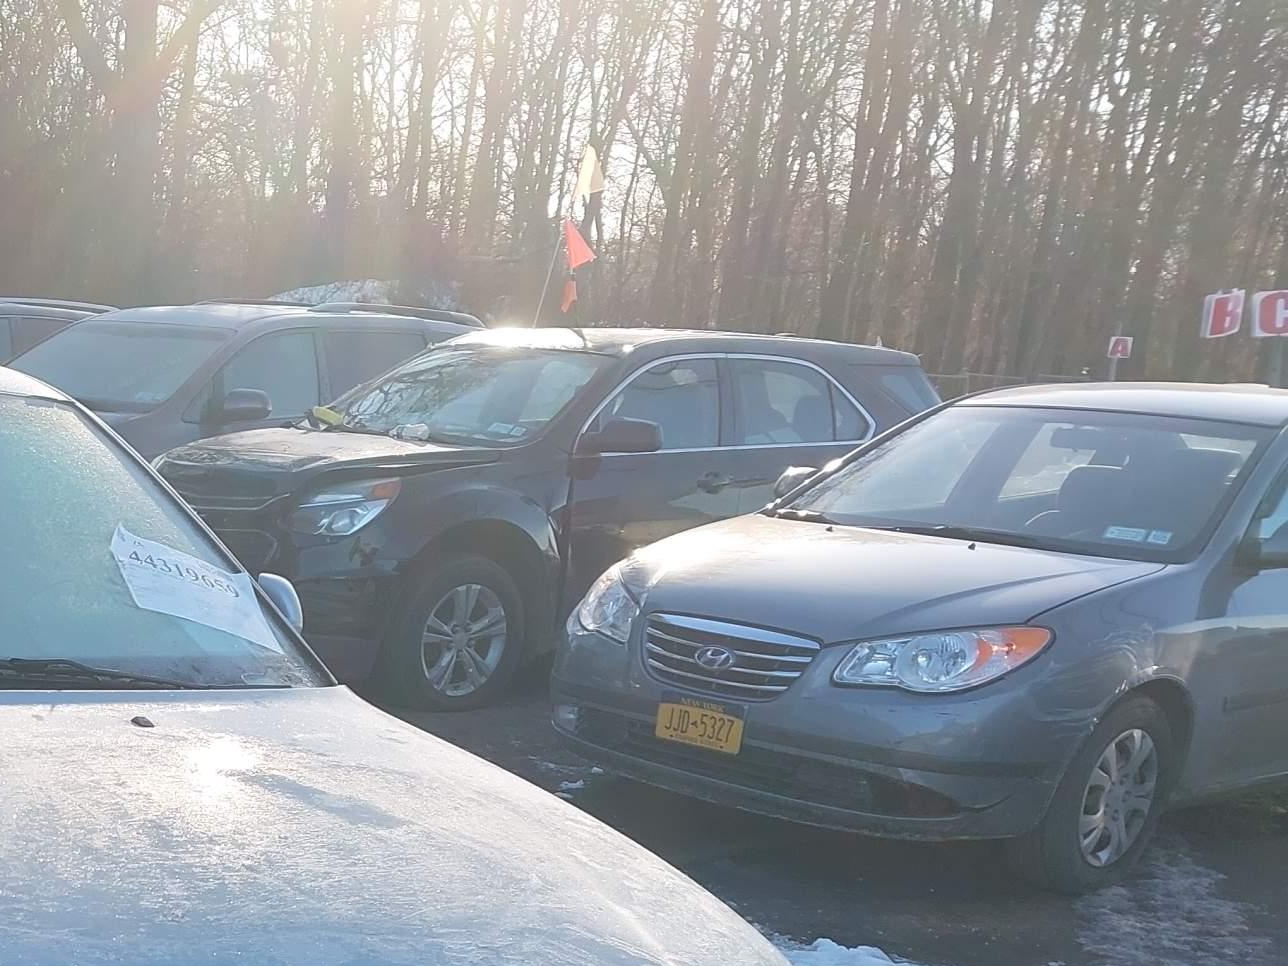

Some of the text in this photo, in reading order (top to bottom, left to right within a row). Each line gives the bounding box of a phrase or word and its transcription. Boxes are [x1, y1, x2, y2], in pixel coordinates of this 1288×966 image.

[1108, 337, 1130, 358] A
[128, 549, 241, 598] 44319659
[664, 707, 690, 734] JJD
[697, 714, 735, 743] 5327
